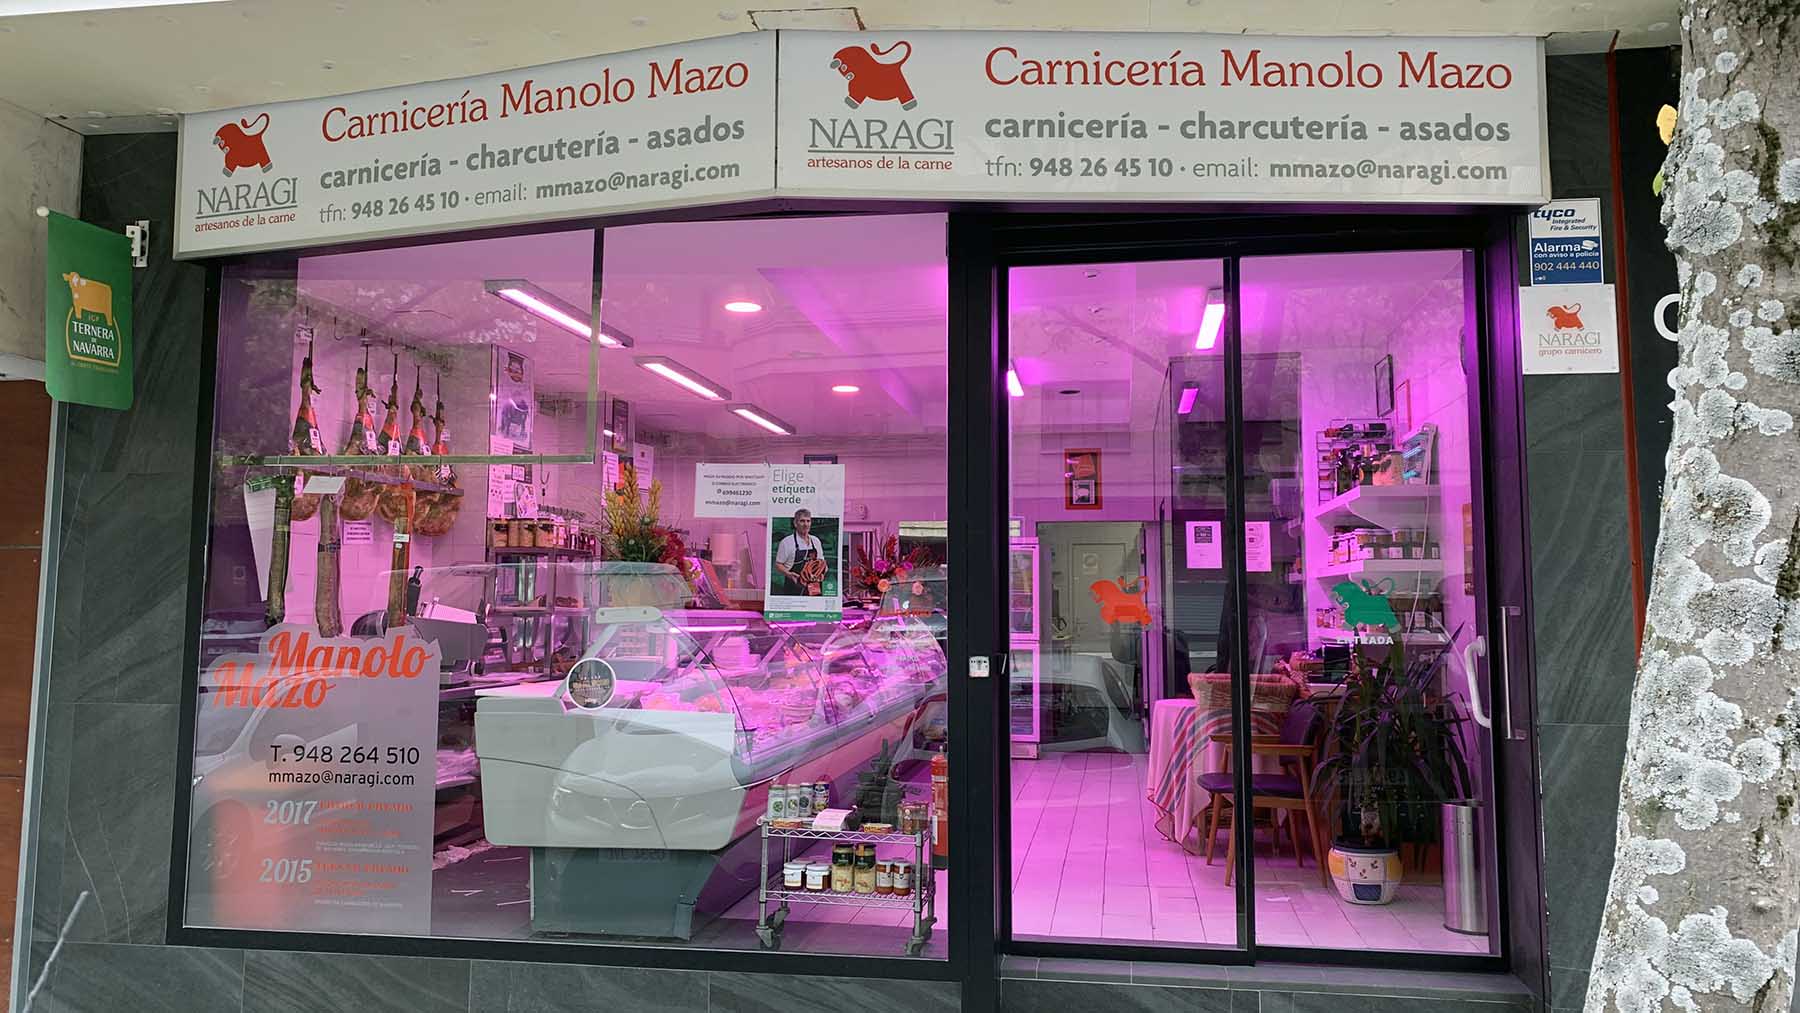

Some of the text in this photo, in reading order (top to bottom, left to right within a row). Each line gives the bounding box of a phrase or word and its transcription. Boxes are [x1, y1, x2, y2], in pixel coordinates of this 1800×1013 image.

[985, 46, 1513, 90] Carnicería Manolo Mazo
[322, 58, 749, 142] Carnicería Manolo Mazo
[808, 117, 955, 151] NARAGI
[985, 111, 1148, 139] carnicería
[1180, 111, 1368, 142] charcutería
[1399, 112, 1511, 142] asados
[320, 153, 441, 190] carnicería
[466, 130, 620, 171] charcutería
[647, 115, 745, 150] asados
[807, 155, 953, 171] artesanos de la carne
[985, 156, 1023, 177] tfn:
[1029, 157, 1073, 177] 948
[1079, 157, 1108, 177] 26
[1114, 158, 1142, 177] 45
[1147, 158, 1174, 177] 10
[1192, 157, 1259, 178] email:
[1269, 159, 1508, 186] mmazo@naragi.com
[196, 177, 298, 215] NARAGI
[320, 206, 347, 224] tfn:
[351, 199, 384, 220] 948
[388, 196, 410, 216] 26
[414, 193, 436, 212] 45
[440, 190, 460, 210] 10
[474, 182, 528, 206] email:
[536, 163, 741, 200] mmazo@naragi.com
[195, 211, 296, 233] artesanos de la carne
[1533, 208, 1575, 221] tyco
[1552, 217, 1586, 225] Integrated
[1570, 224, 1598, 232] Security
[1534, 242, 1581, 253] Alarma
[1534, 260, 1600, 272] 902 444 440
[71, 320, 115, 341] TERNERA
[1538, 331, 1601, 346] NARAGI
[72, 339, 115, 360] NAVARRA
[1538, 346, 1602, 357] grupo carnicero
[773, 468, 804, 486] Elige
[771, 495, 801, 504] verde
[772, 484, 816, 496] etiqueta
[267, 631, 434, 679] Manolo
[212, 661, 337, 709] Mazo
[270, 744, 420, 765] T. 948 264 510
[268, 769, 415, 788] mmazo@naragi.com
[263, 799, 318, 825] 2017
[259, 858, 313, 884] 2015
